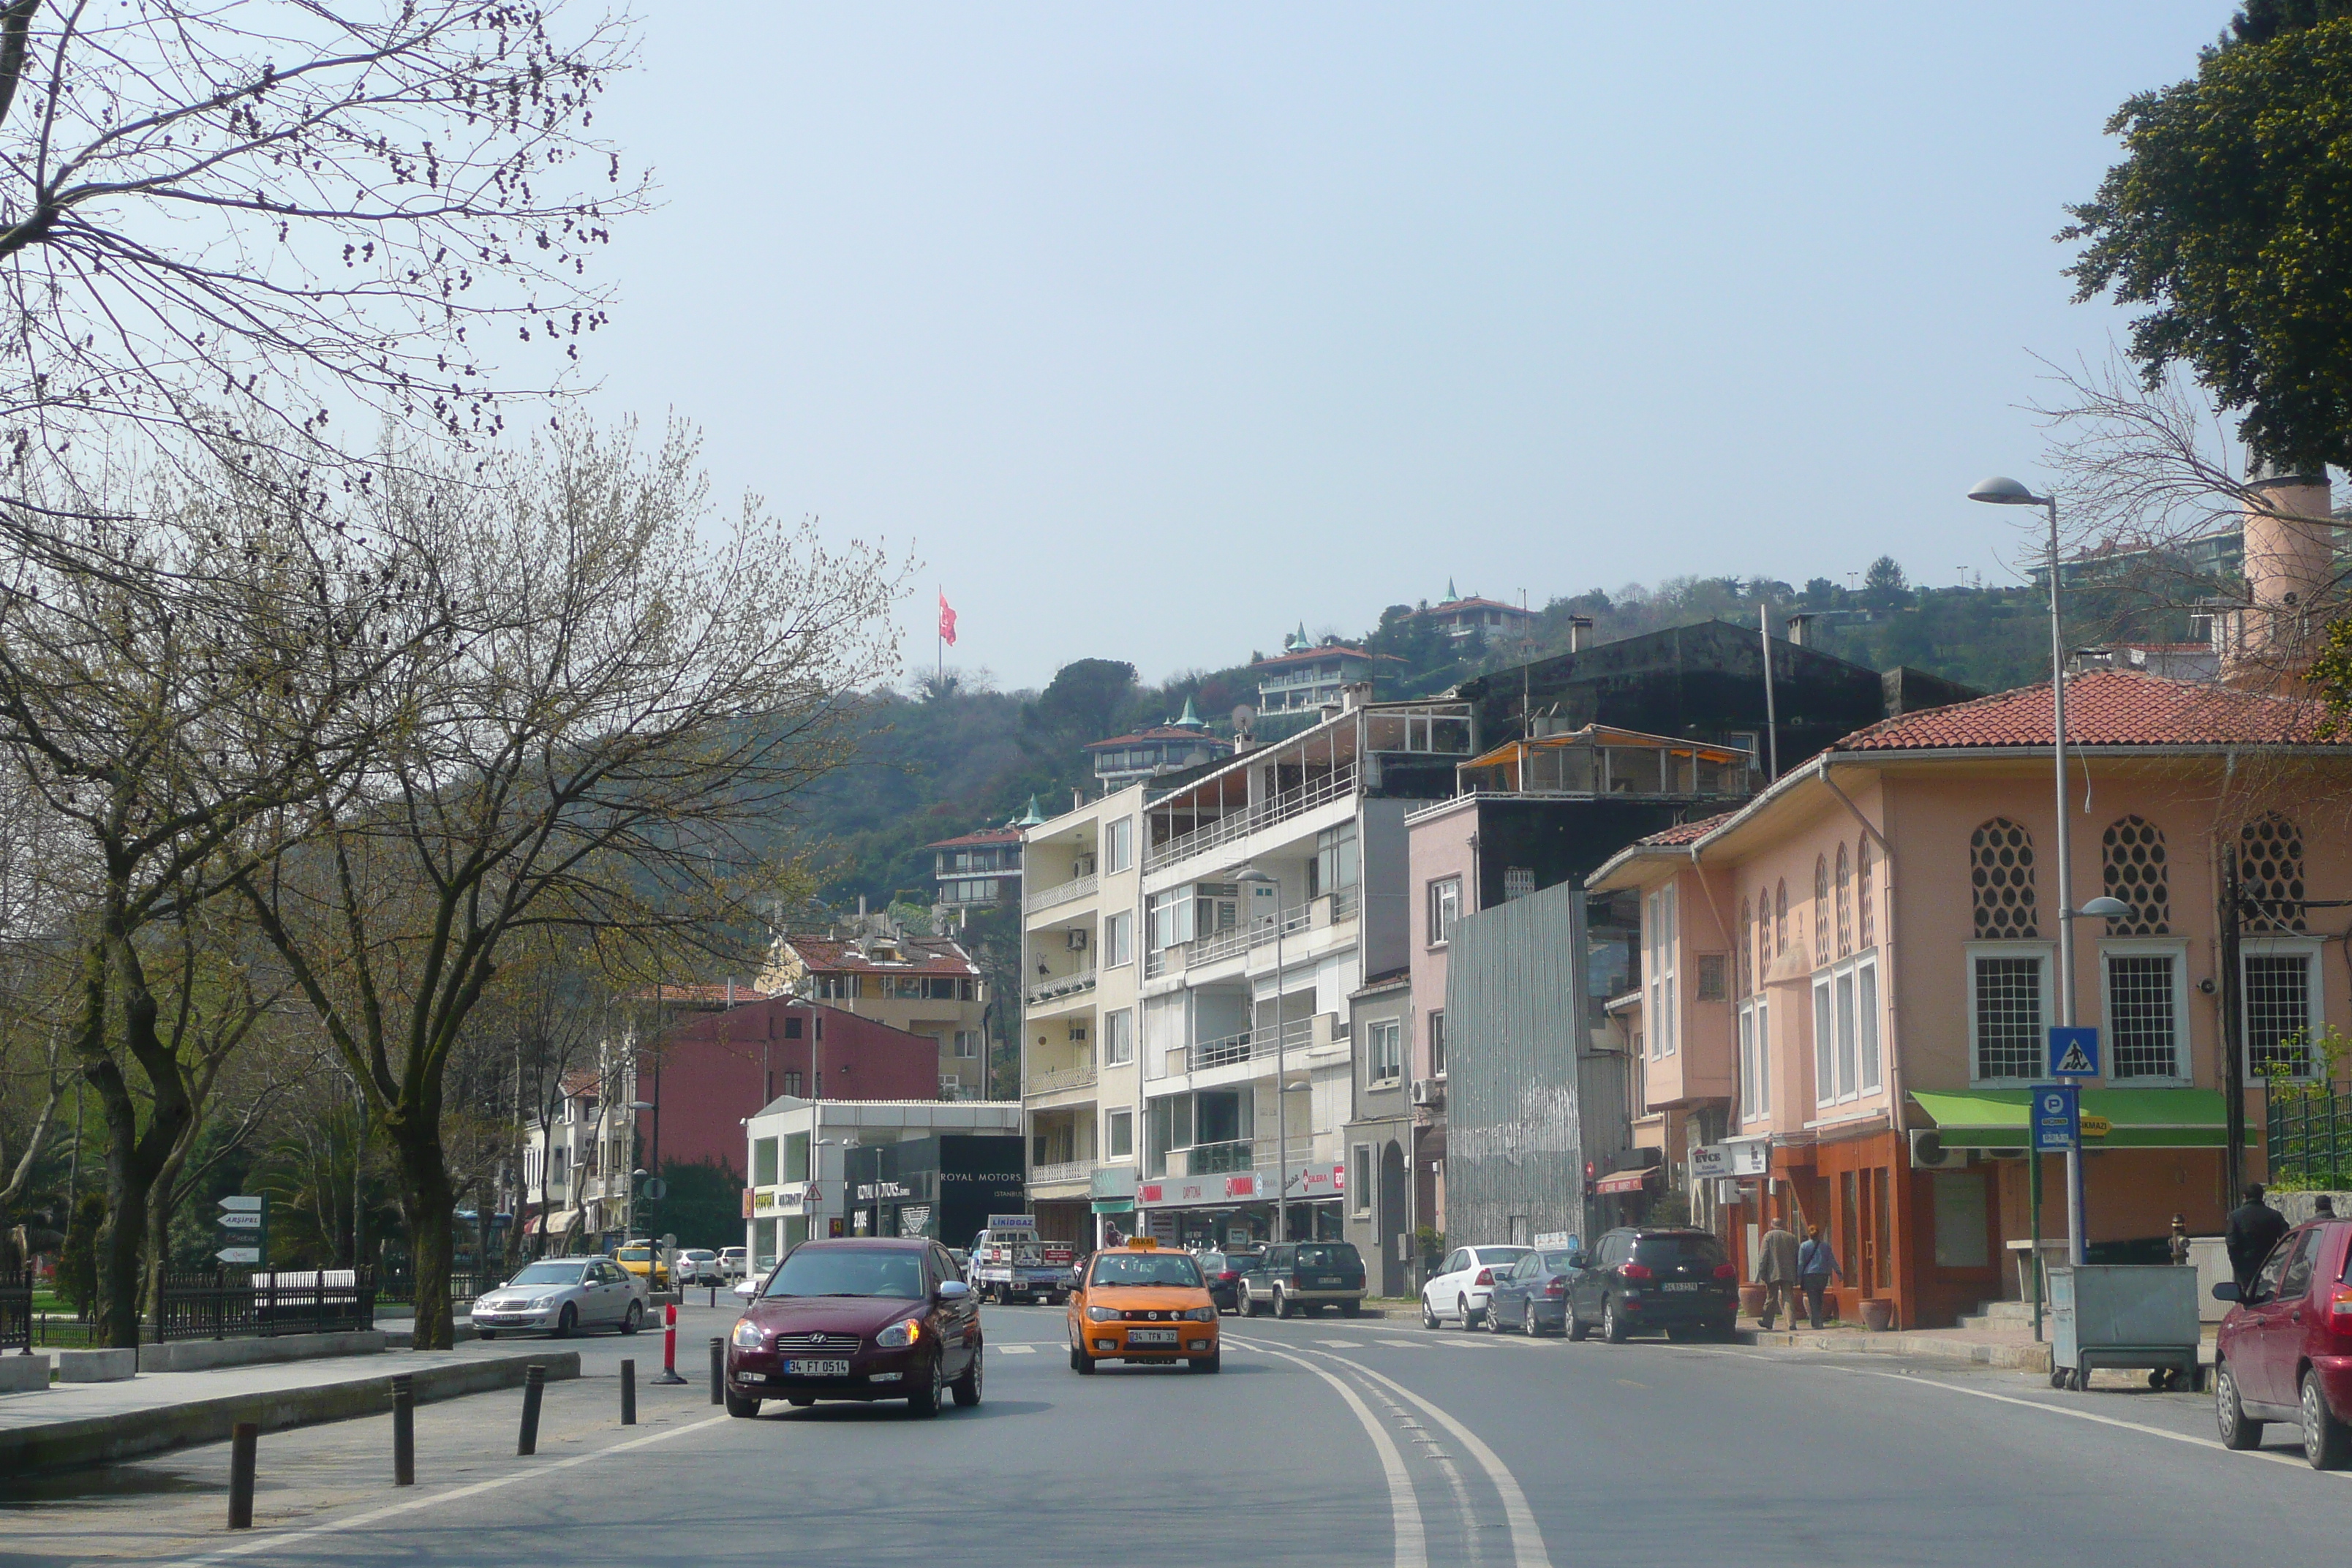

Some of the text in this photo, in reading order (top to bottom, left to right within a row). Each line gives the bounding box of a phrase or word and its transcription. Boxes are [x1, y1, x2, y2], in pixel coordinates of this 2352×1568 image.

[2080, 1122, 2107, 1130] IKMAZI
[941, 1173, 1022, 1181] ROYAL MOTORS
[992, 1218, 1033, 1226] LİKİDGAZ
[1134, 1333, 1142, 1341] 34
[1166, 1333, 1175, 1341] 32
[790, 1361, 846, 1372] 34 FT 0514
